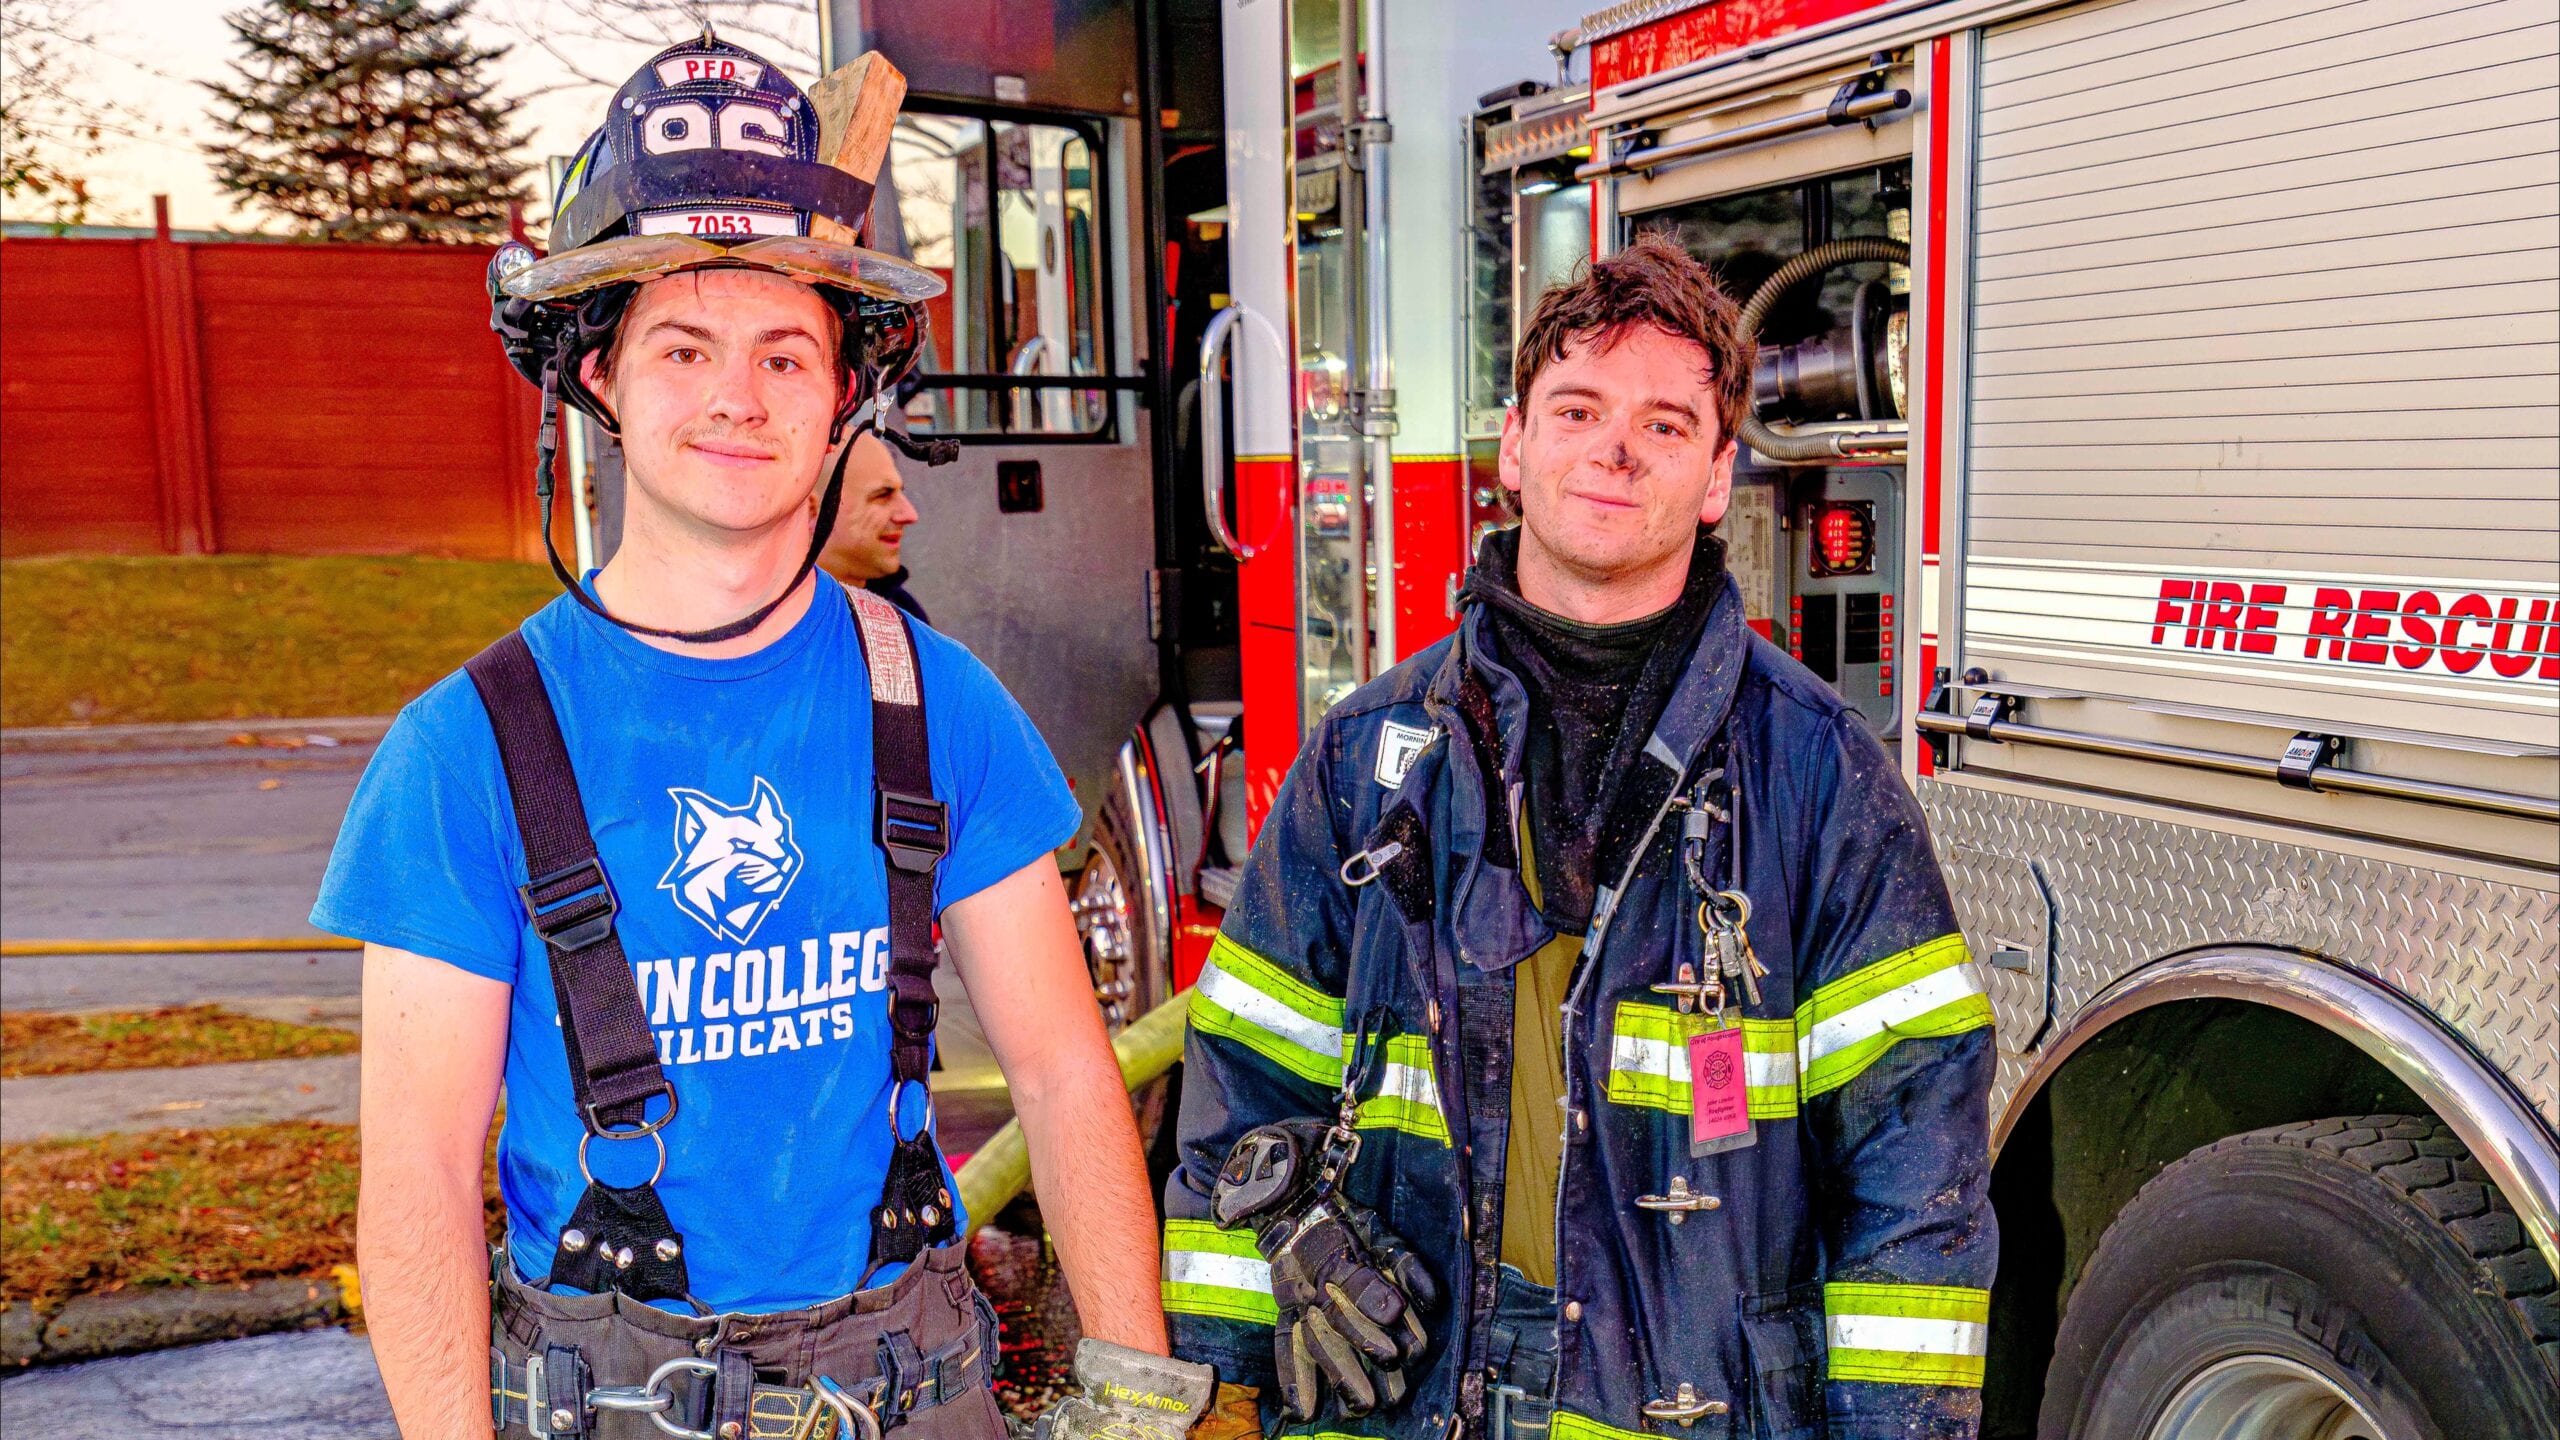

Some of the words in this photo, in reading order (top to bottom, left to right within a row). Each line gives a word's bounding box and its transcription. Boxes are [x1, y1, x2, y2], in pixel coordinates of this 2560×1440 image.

[685, 60, 735, 80] PFD
[687, 215, 753, 235] 7053
[2151, 579, 2287, 655] FIRE
[652, 1003, 854, 1066] ILDCATS
